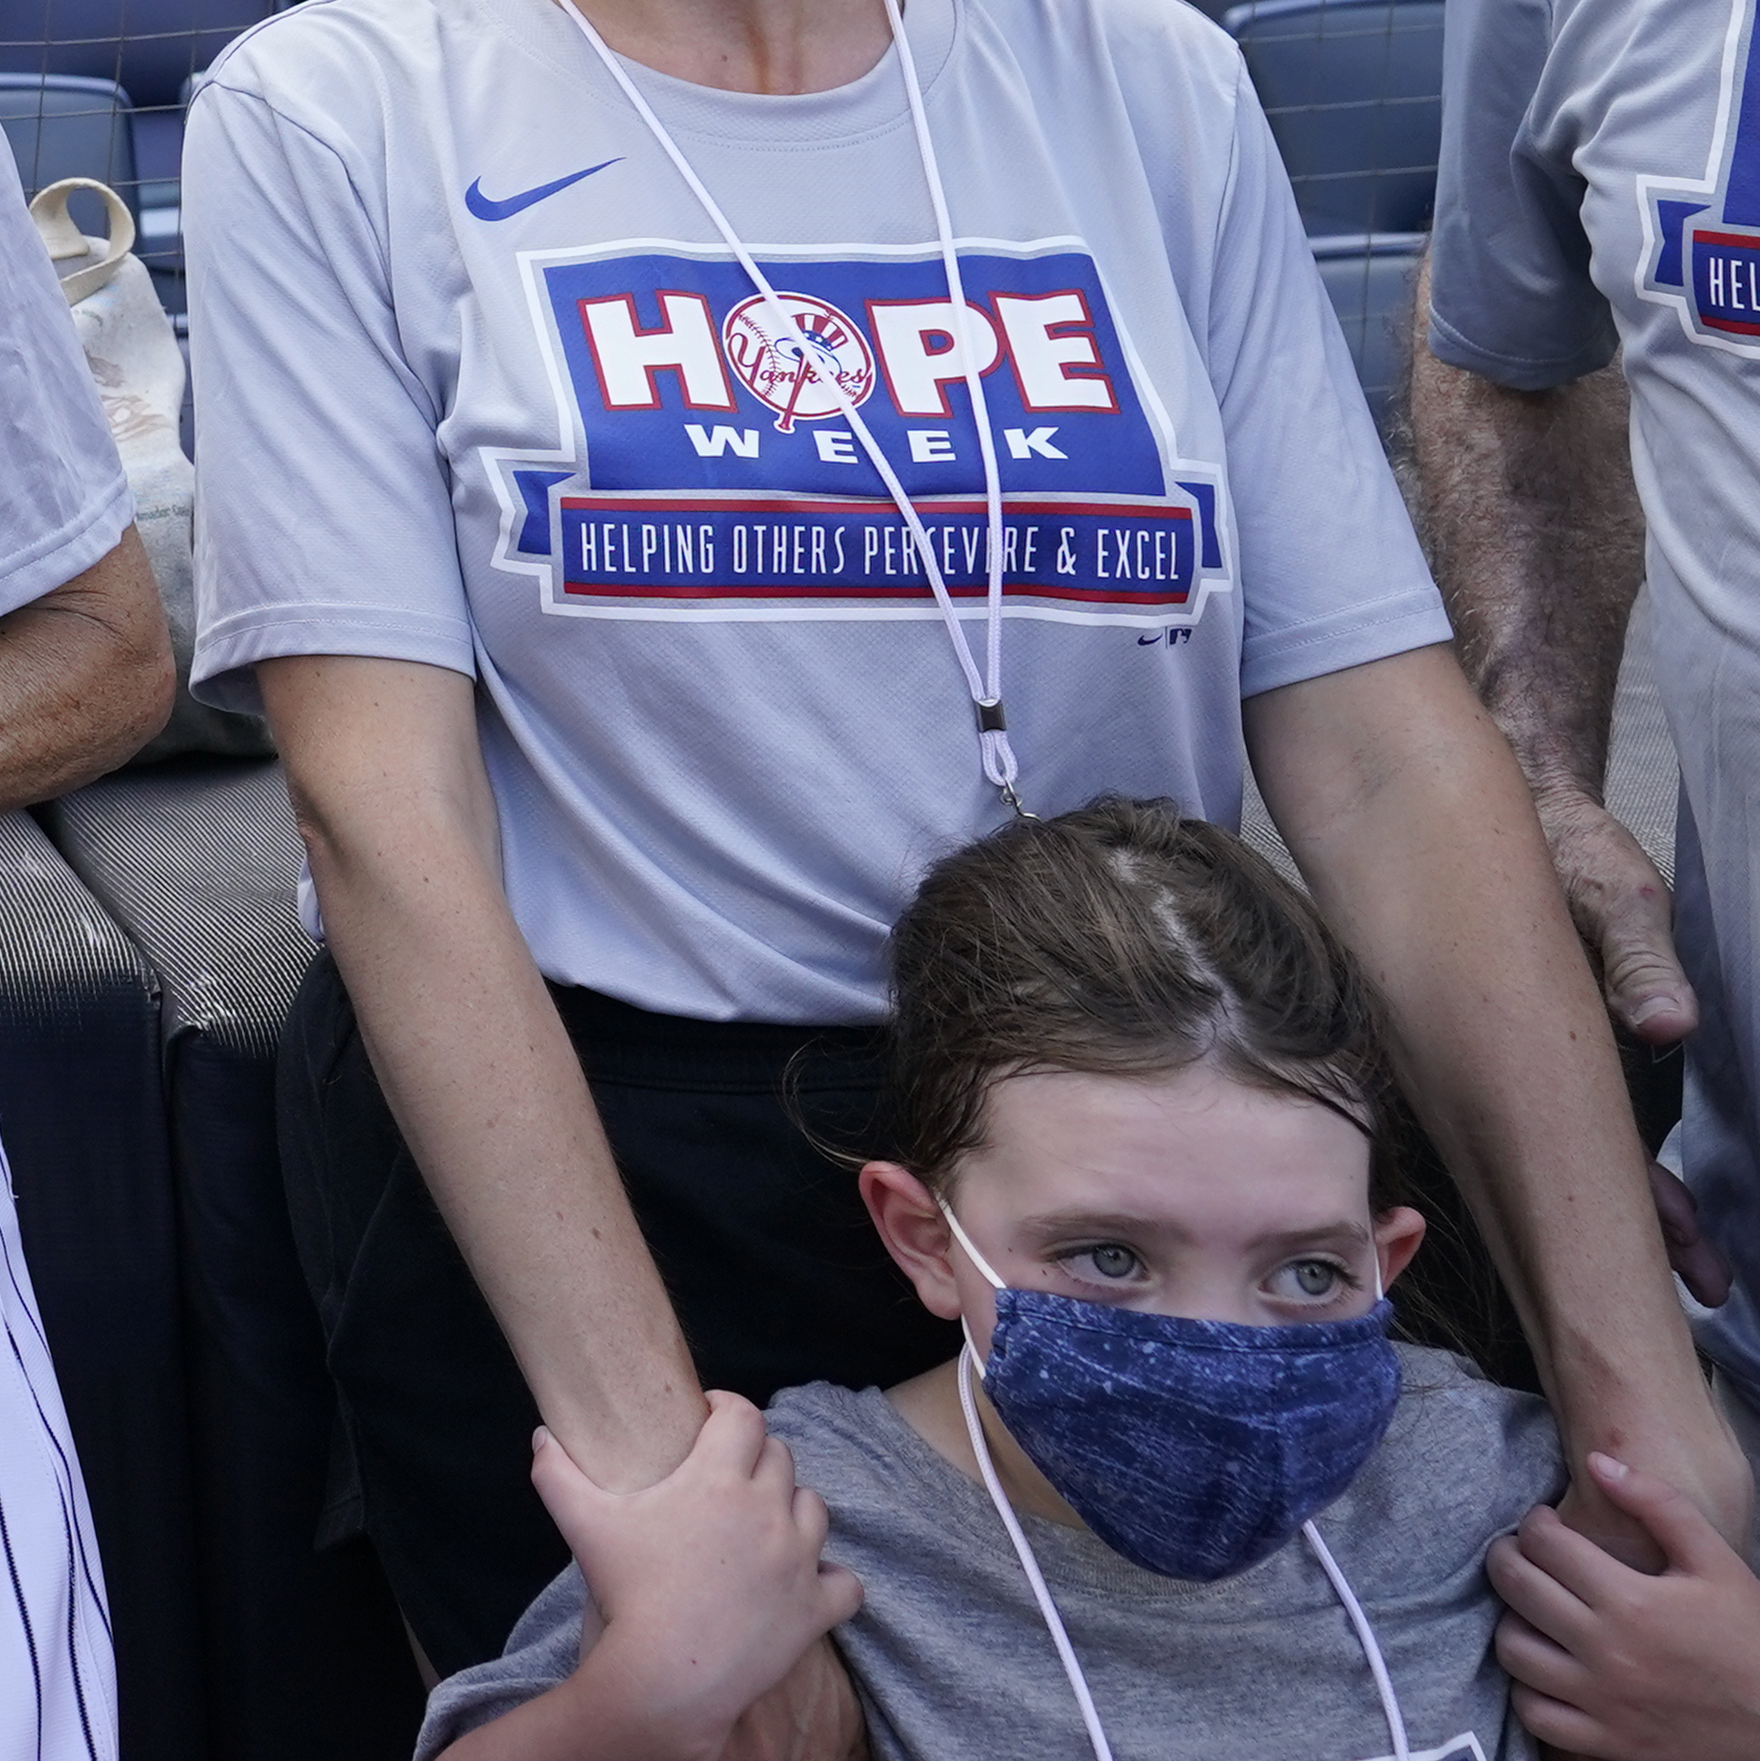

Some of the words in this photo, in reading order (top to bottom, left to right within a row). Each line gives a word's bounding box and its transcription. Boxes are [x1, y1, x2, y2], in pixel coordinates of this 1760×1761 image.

[683, 422, 1071, 464] WEEK
[580, 522, 715, 574] HELPING
[732, 524, 846, 575] OTHERS
[1056, 526, 1078, 576] &
[1096, 528, 1180, 581] EXCEL
